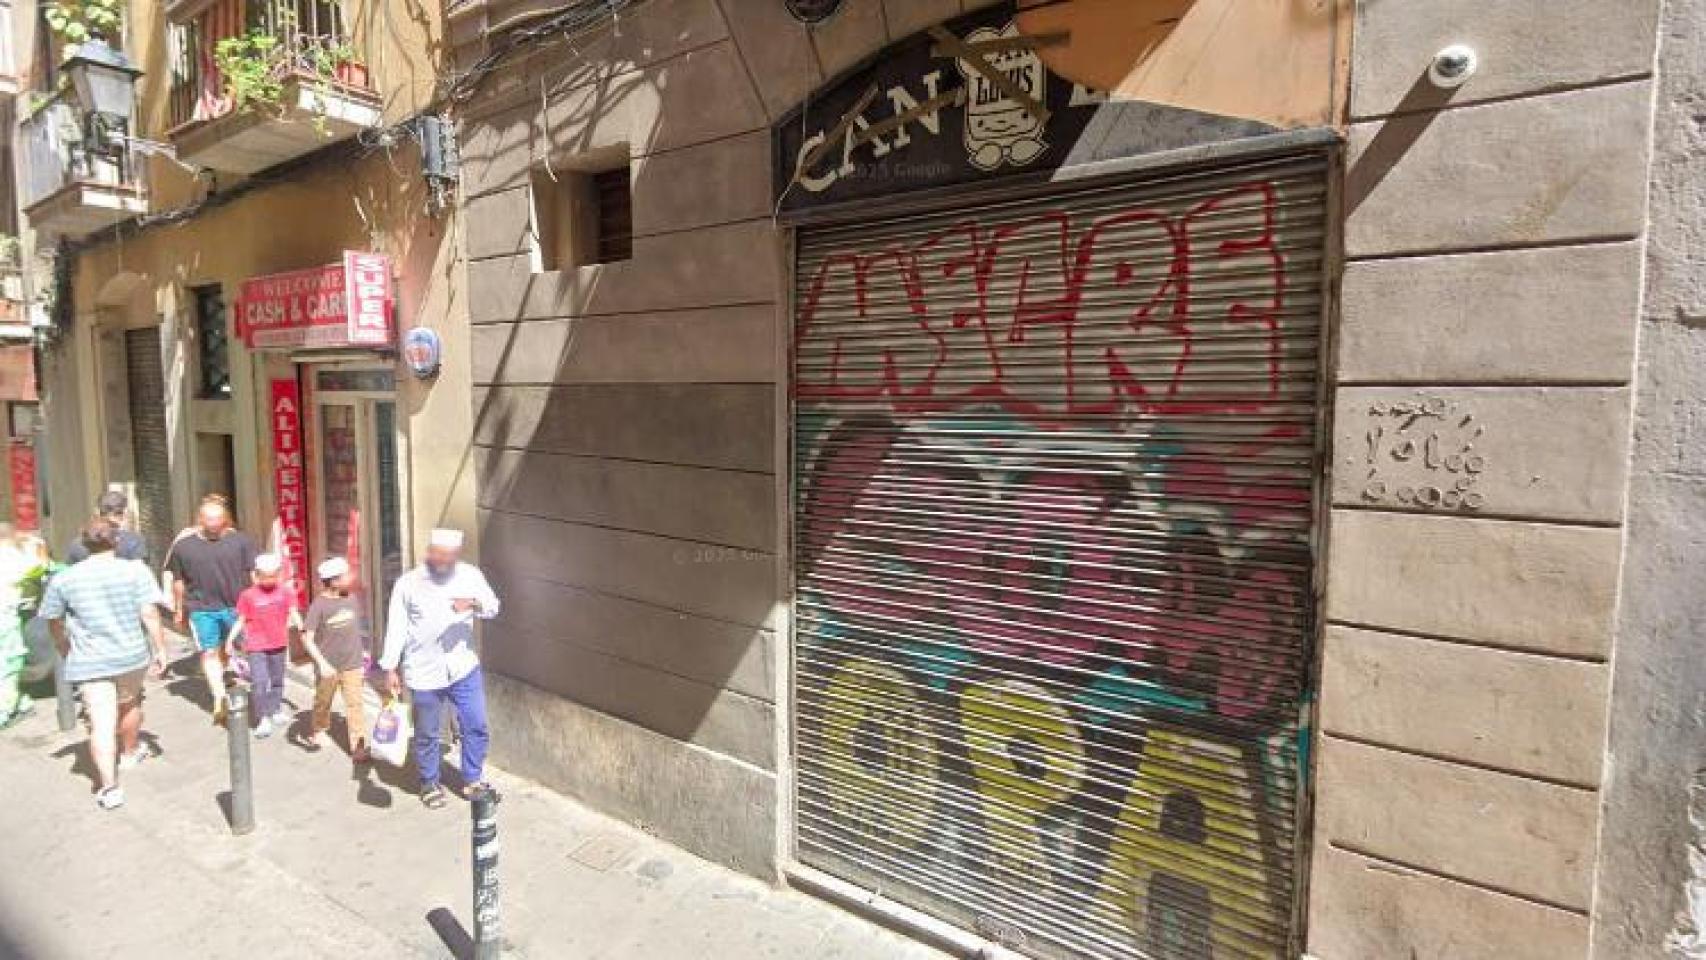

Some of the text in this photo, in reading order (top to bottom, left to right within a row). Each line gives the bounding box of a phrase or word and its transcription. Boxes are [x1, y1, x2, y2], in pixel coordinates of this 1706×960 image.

[247, 299, 285, 324] CASH
[290, 295, 303, 322] &
[354, 255, 386, 330] SUPER
